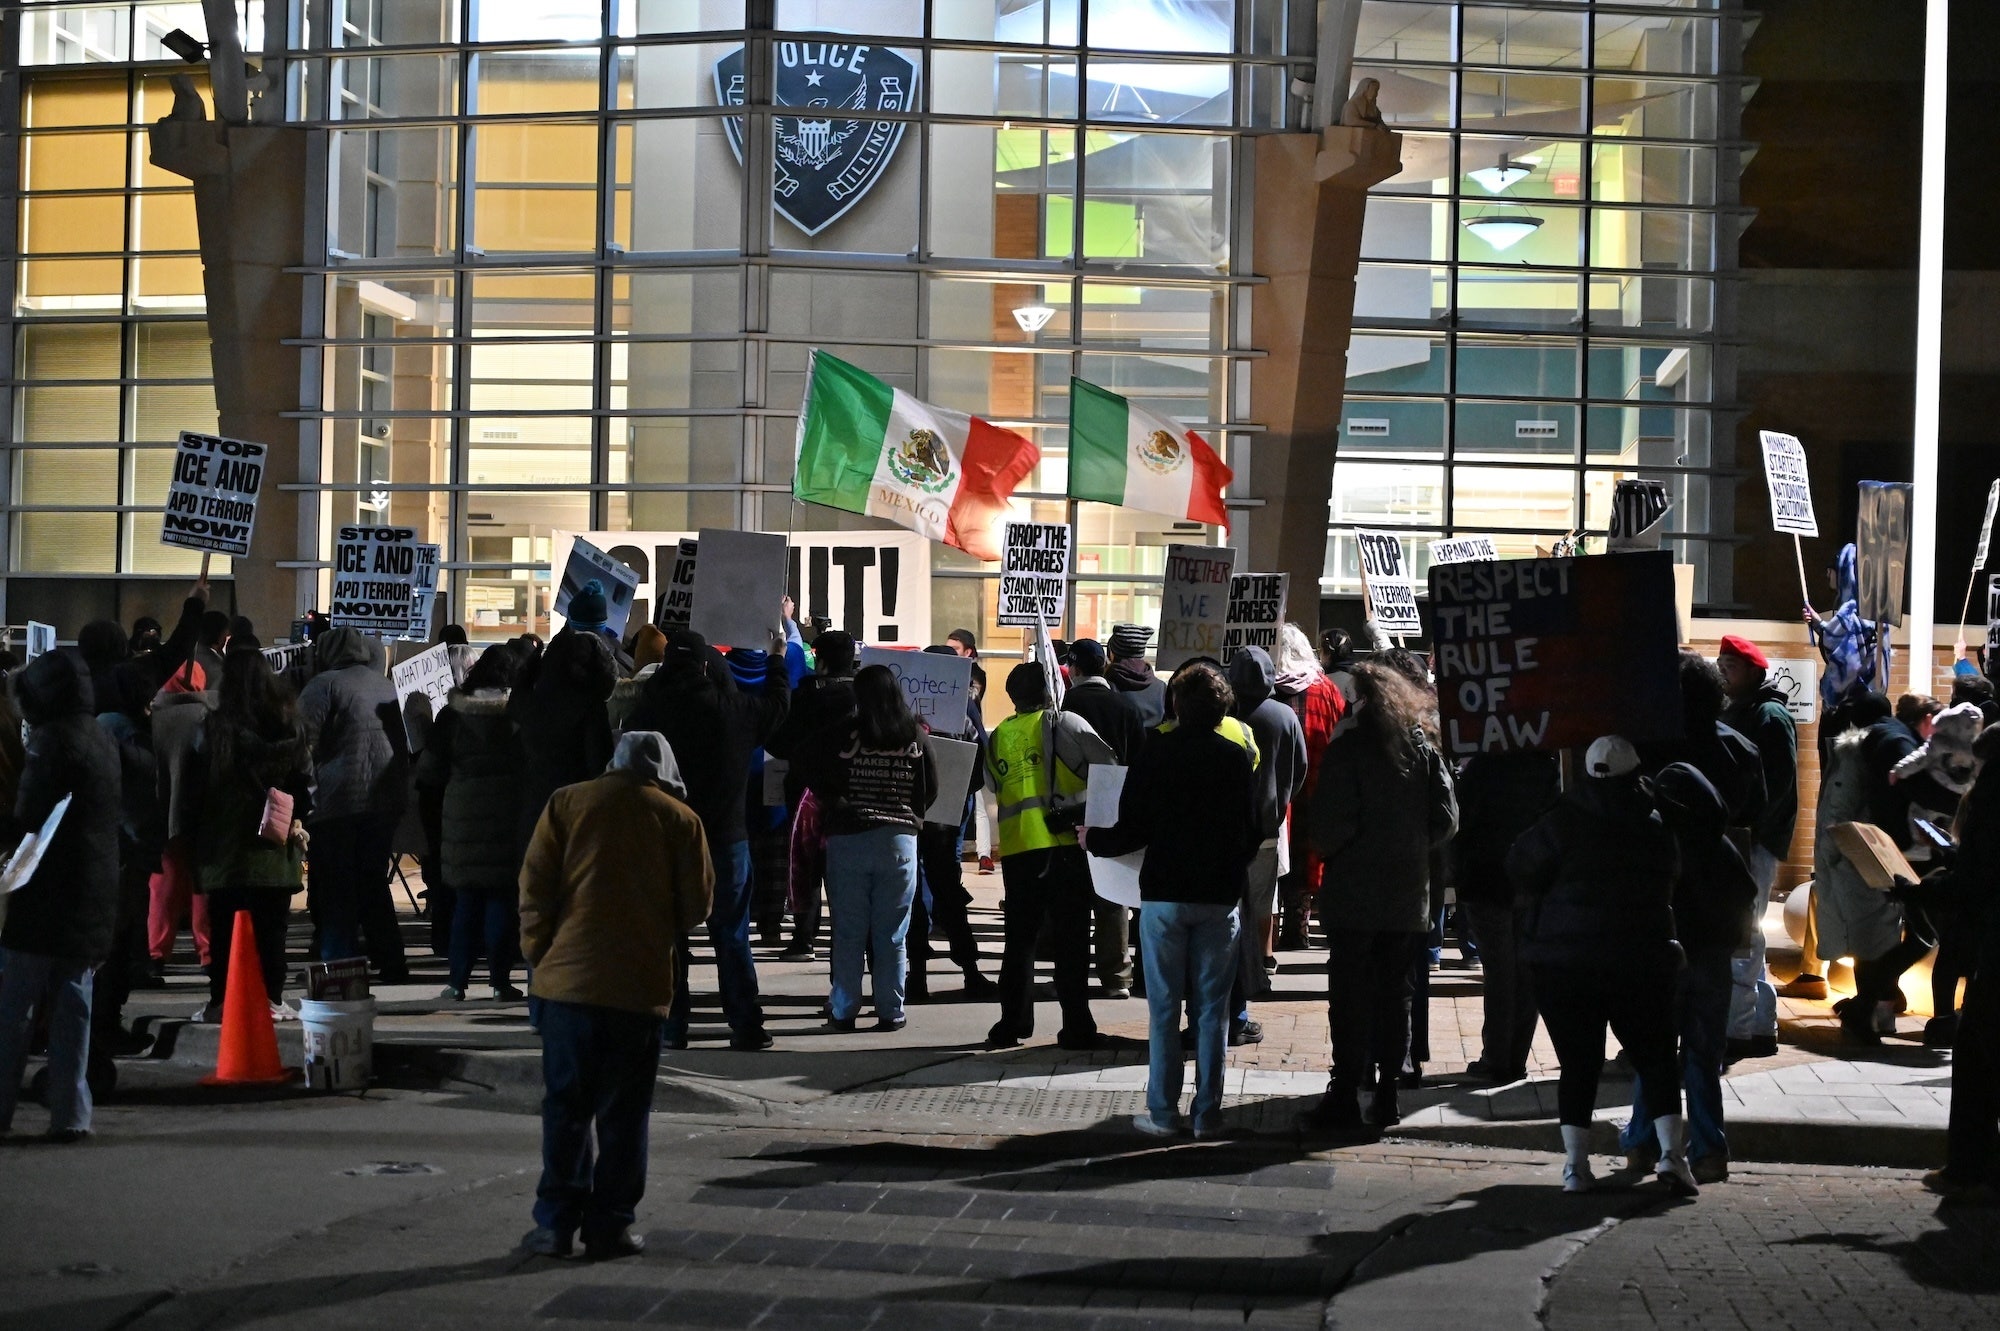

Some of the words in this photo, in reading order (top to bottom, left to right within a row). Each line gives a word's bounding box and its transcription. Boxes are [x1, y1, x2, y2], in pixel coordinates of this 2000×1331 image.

[781, 42, 870, 75] OLICE
[846, 98, 897, 183] ILLINOS
[182, 434, 263, 458] STOP
[174, 452, 211, 486] ICE
[215, 459, 261, 494] AND
[1771, 472, 1787, 481] TIME
[1789, 474, 1801, 482] FOR
[168, 491, 199, 514] APD
[200, 496, 254, 523] TERROR
[879, 489, 939, 523] MEXICO
[165, 514, 249, 540] NOW!
[340, 527, 413, 542] STOP
[1008, 524, 1042, 548] DROP
[1044, 525, 1067, 549] THE
[337, 544, 367, 573] ICE
[374, 545, 414, 574] AND
[416, 547, 436, 564] THE
[1007, 548, 1065, 573] CHARGES
[1359, 533, 1401, 576] STOP
[1434, 541, 1475, 562] EXPAND
[1473, 539, 1494, 556] THE
[673, 559, 696, 585] IC
[1169, 556, 1231, 584] TOGETHER
[1434, 560, 1573, 602] RESPECT
[335, 581, 359, 599] APD
[362, 582, 411, 601] TERROR
[1003, 577, 1034, 595] STAND
[1036, 578, 1063, 596] WITH
[1230, 577, 1250, 600] OP
[1252, 576, 1282, 599] THE
[1379, 585, 1413, 604] TERROR
[333, 602, 409, 617] NOW!
[1177, 594, 1210, 618] WE
[1226, 600, 1278, 624] ARGES
[1376, 604, 1417, 619] NOW!
[1436, 602, 1512, 640] THE
[1163, 619, 1222, 653] RISE
[1245, 628, 1277, 646] WITH
[267, 652, 282, 670] ND
[1440, 637, 1539, 678] RULE
[394, 661, 419, 689] WHAT
[422, 658, 432, 676] DO
[427, 673, 453, 701] EYES
[1458, 676, 1511, 713] OF
[1449, 711, 1550, 754] LAW
[848, 767, 890, 778] THINGS
[891, 770, 916, 781] NEW
[853, 758, 890, 767] MAKES
[892, 759, 912, 769] ALL
